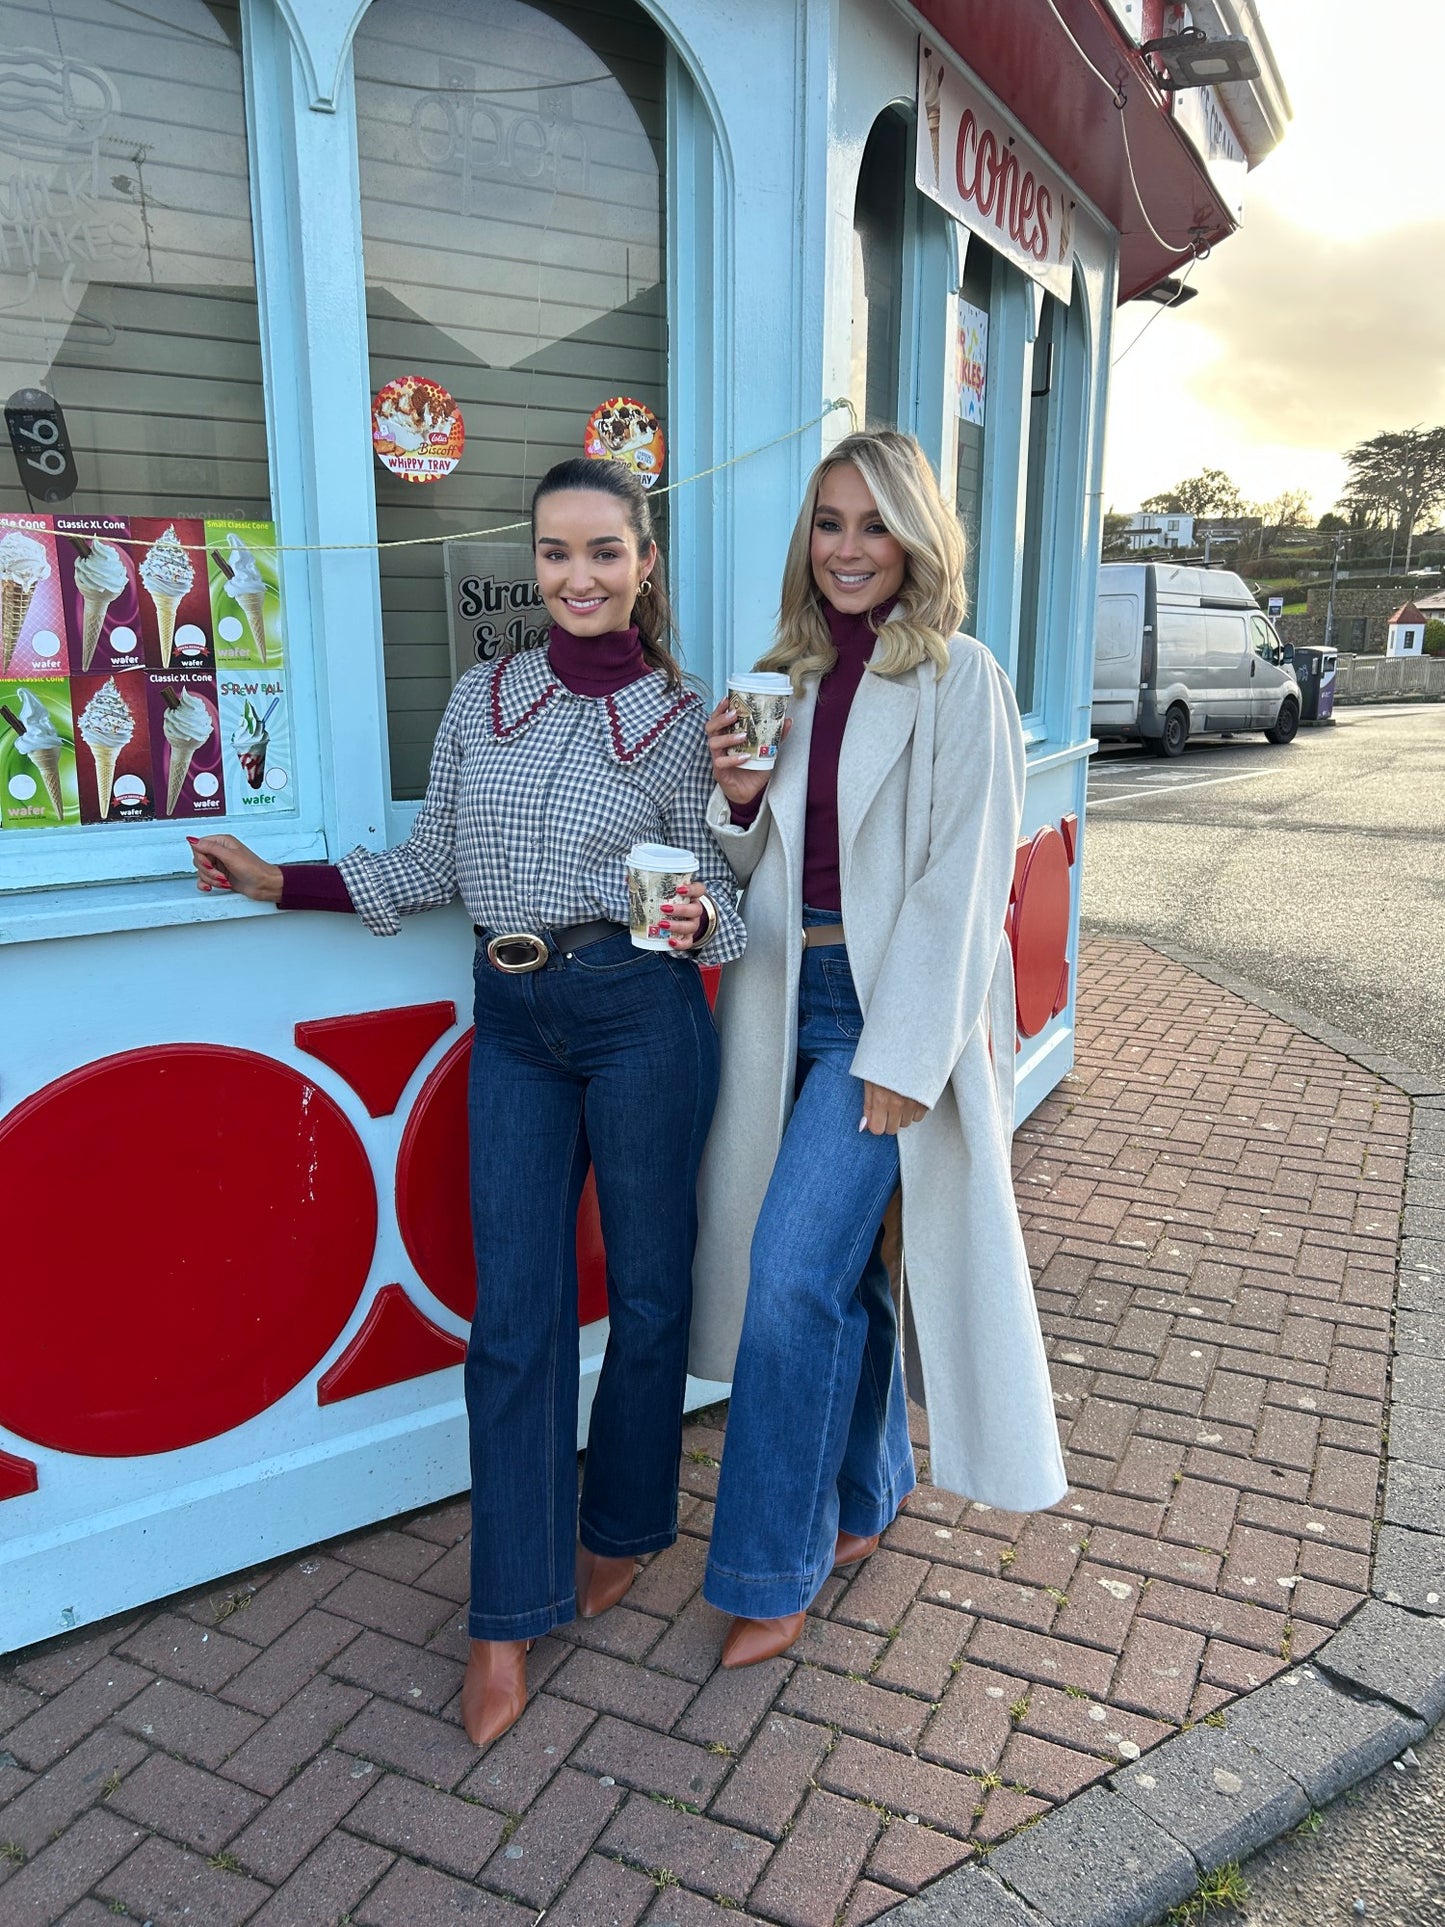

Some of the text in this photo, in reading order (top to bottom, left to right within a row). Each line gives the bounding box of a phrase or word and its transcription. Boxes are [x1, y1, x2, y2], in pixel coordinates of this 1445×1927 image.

[955, 108, 1052, 261] cones
[0, 220, 143, 270] HAKES
[418, 443, 457, 455] Biscoff
[429, 459, 452, 471] TRAY
[19, 519, 46, 530] Cone
[57, 520, 126, 530] Classic XL Cone
[206, 520, 269, 530] Small Classic Cone
[217, 647, 251, 658] wafer
[31, 660, 61, 669] wafer
[110, 655, 139, 665] wafer
[181, 659, 204, 667] wafer
[149, 673, 213, 683] Classic XL Cone
[193, 799, 220, 808] wafer
[242, 794, 276, 805] wafer
[8, 805, 45, 817] wafer
[120, 808, 143, 817] wafer
